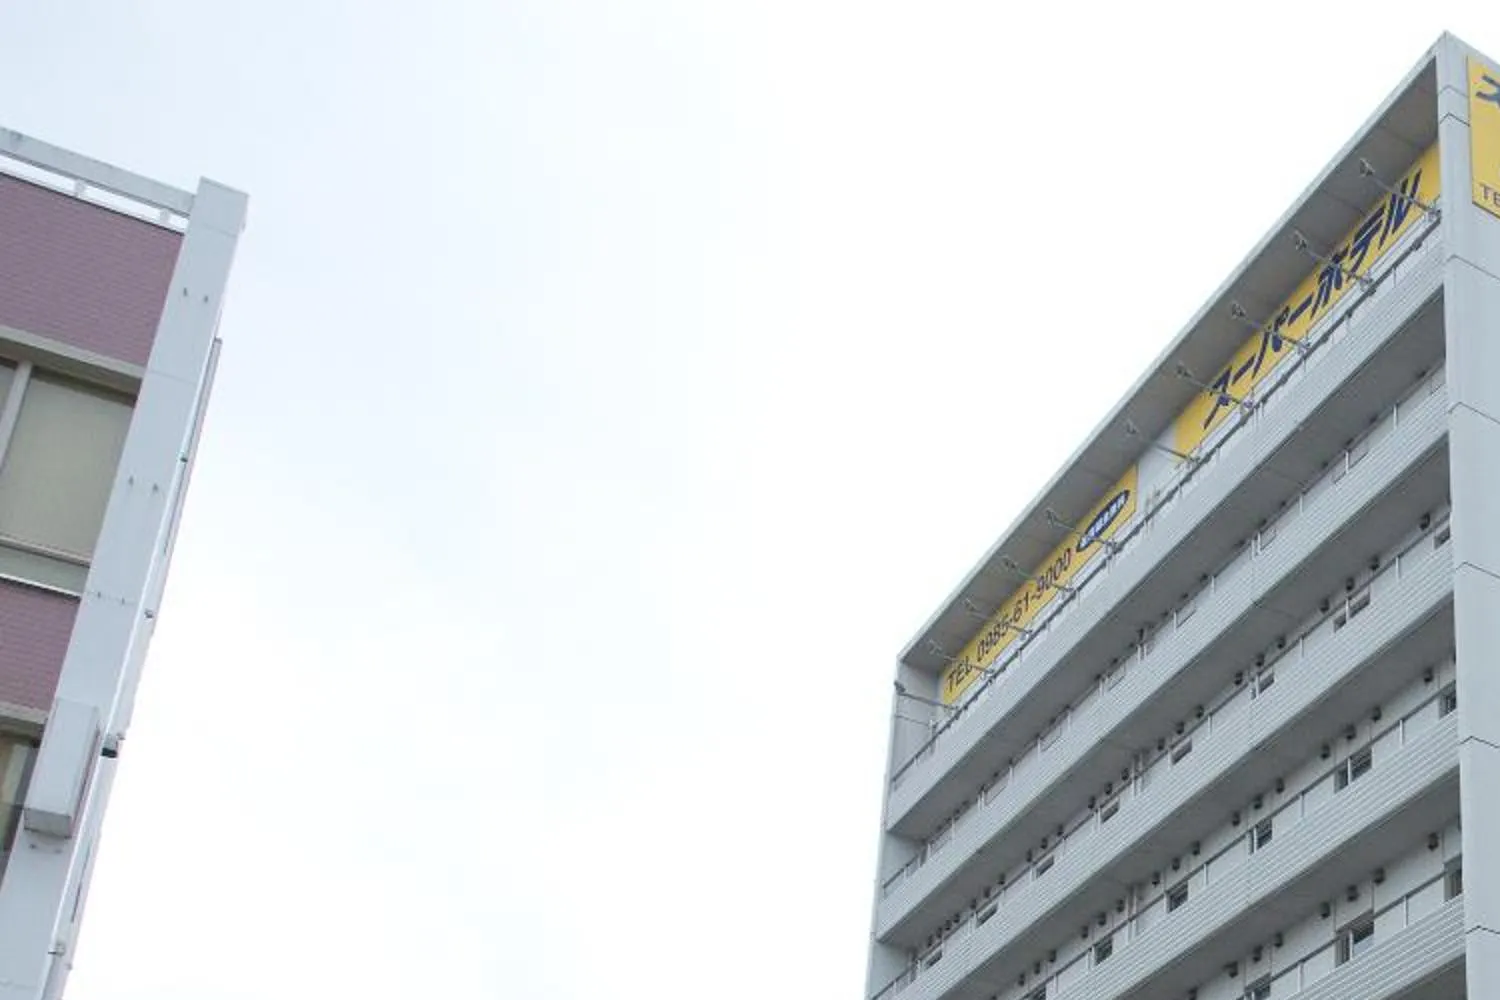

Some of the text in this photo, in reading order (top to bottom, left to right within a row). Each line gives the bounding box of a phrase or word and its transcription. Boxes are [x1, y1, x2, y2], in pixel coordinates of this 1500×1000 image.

[1203, 168, 1423, 430] スーパーホテル
[947, 655, 973, 693] TEL
